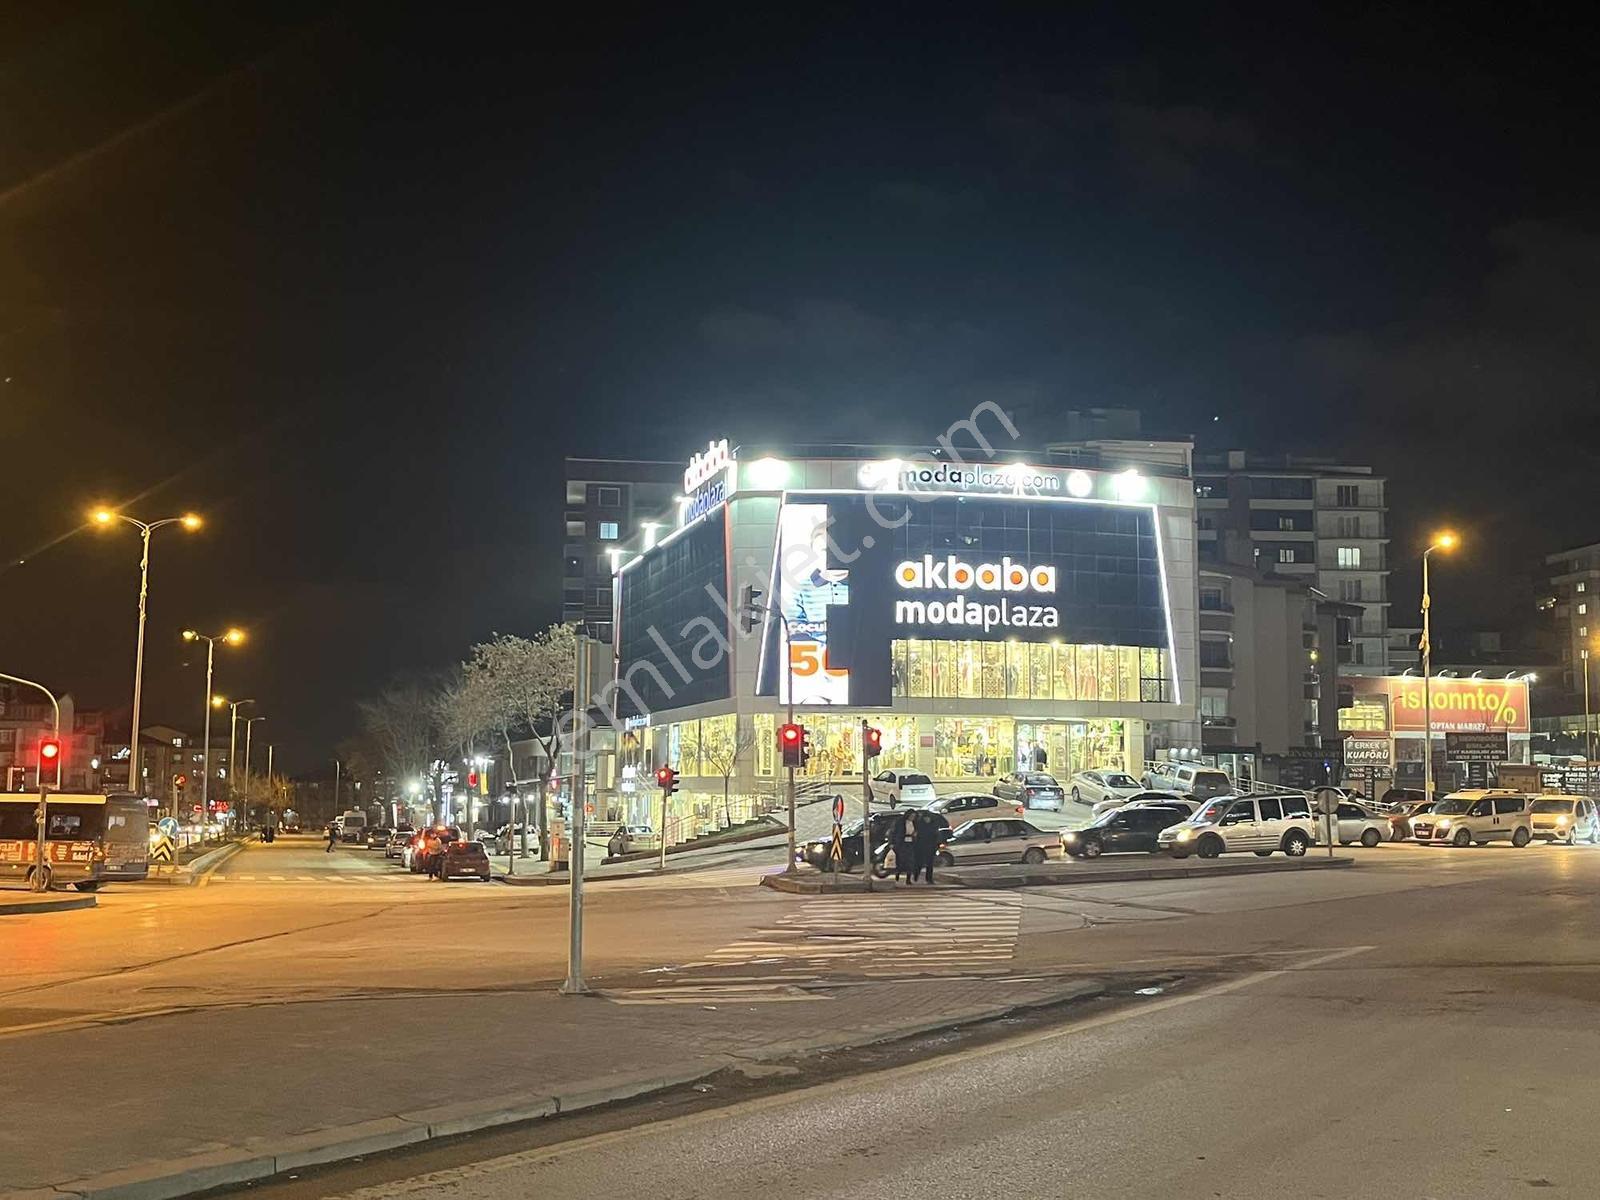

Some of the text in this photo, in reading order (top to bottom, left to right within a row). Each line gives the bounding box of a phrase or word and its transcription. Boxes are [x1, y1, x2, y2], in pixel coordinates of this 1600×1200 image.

[905, 464, 1060, 488] modaplazacom
[895, 554, 1057, 593] akbaba
[895, 595, 1059, 632] modaplaza
